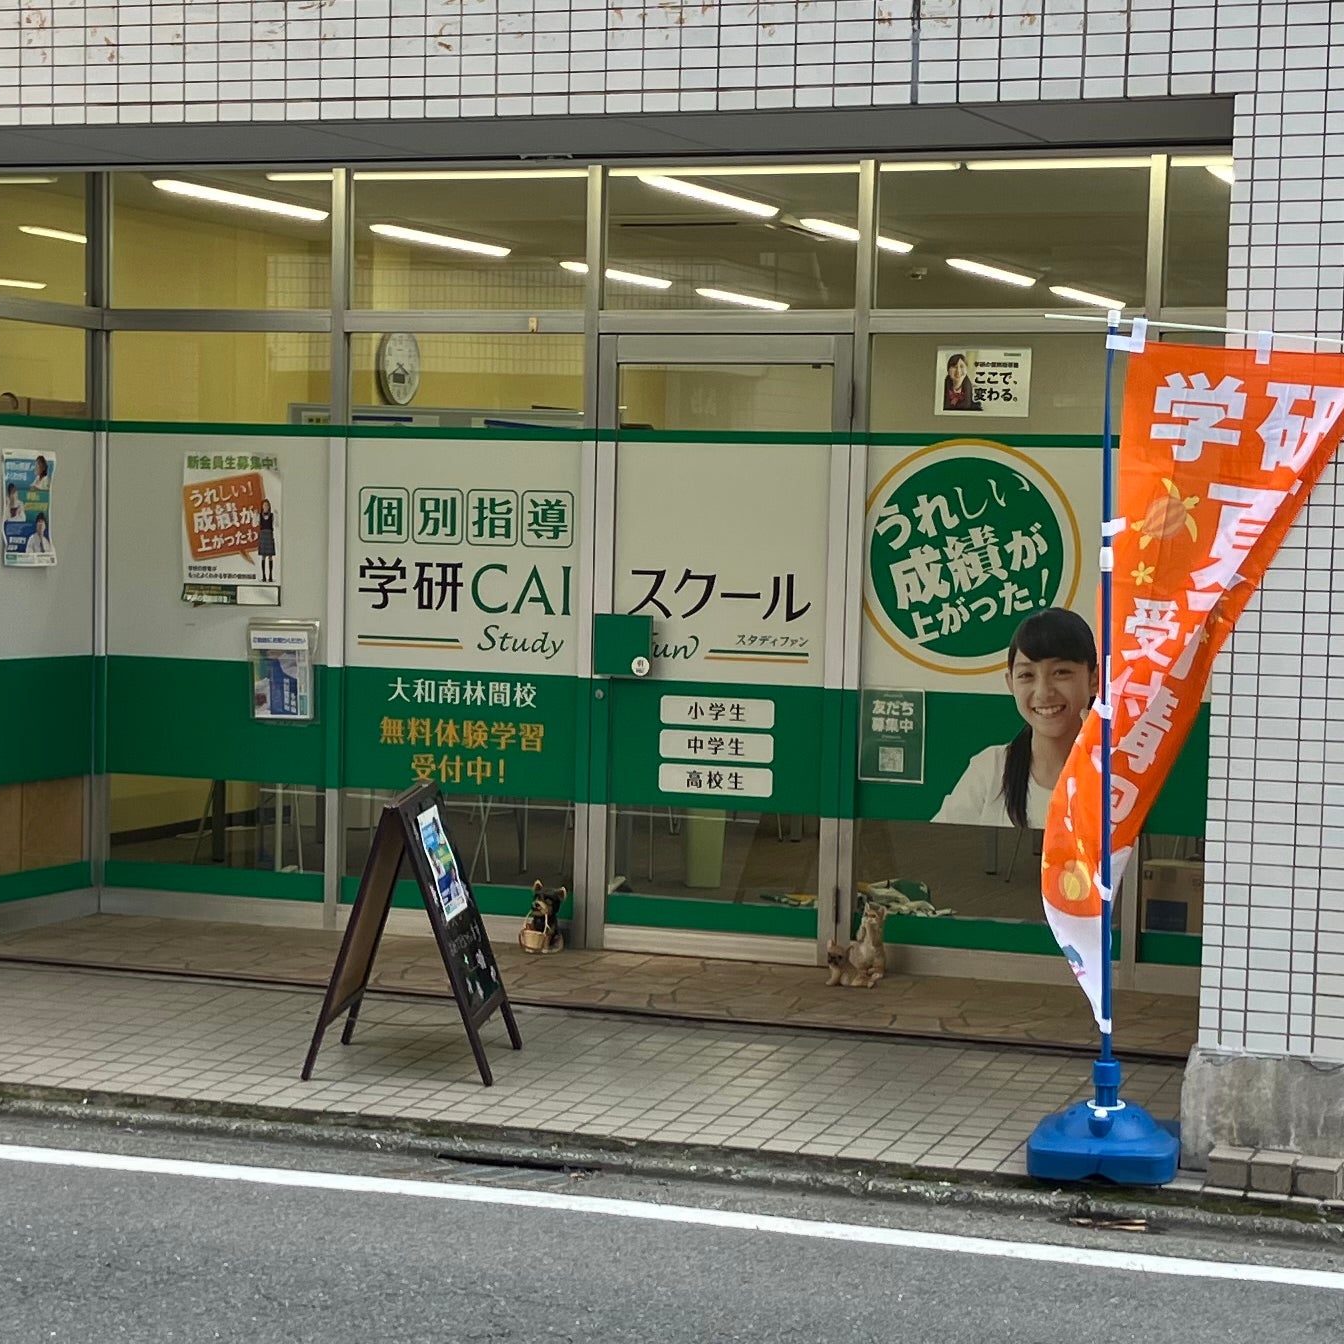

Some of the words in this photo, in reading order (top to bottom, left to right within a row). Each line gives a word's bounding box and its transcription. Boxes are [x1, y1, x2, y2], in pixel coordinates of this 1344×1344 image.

[974, 371, 1018, 385] ここで、
[974, 388, 1018, 402] 変わる。
[190, 481, 254, 507] うれしい!
[363, 495, 569, 541] 個別指導
[875, 473, 1030, 550] うれしい
[888, 521, 1049, 611] 成績が
[357, 556, 573, 616] 学研CAI
[628, 567, 811, 622] スクール
[909, 569, 1051, 646] 上がった!
[476, 624, 564, 660] Study
[652, 632, 700, 660] un
[735, 633, 809, 648] スタディファン
[387, 676, 538, 709] 大和南林間校
[872, 699, 914, 717] 友だち
[687, 702, 747, 723] 小学生
[379, 716, 545, 753] 無料体験学習
[686, 736, 745, 757] 中学生
[411, 753, 505, 785] 受付中!
[685, 770, 745, 791] 高校生
